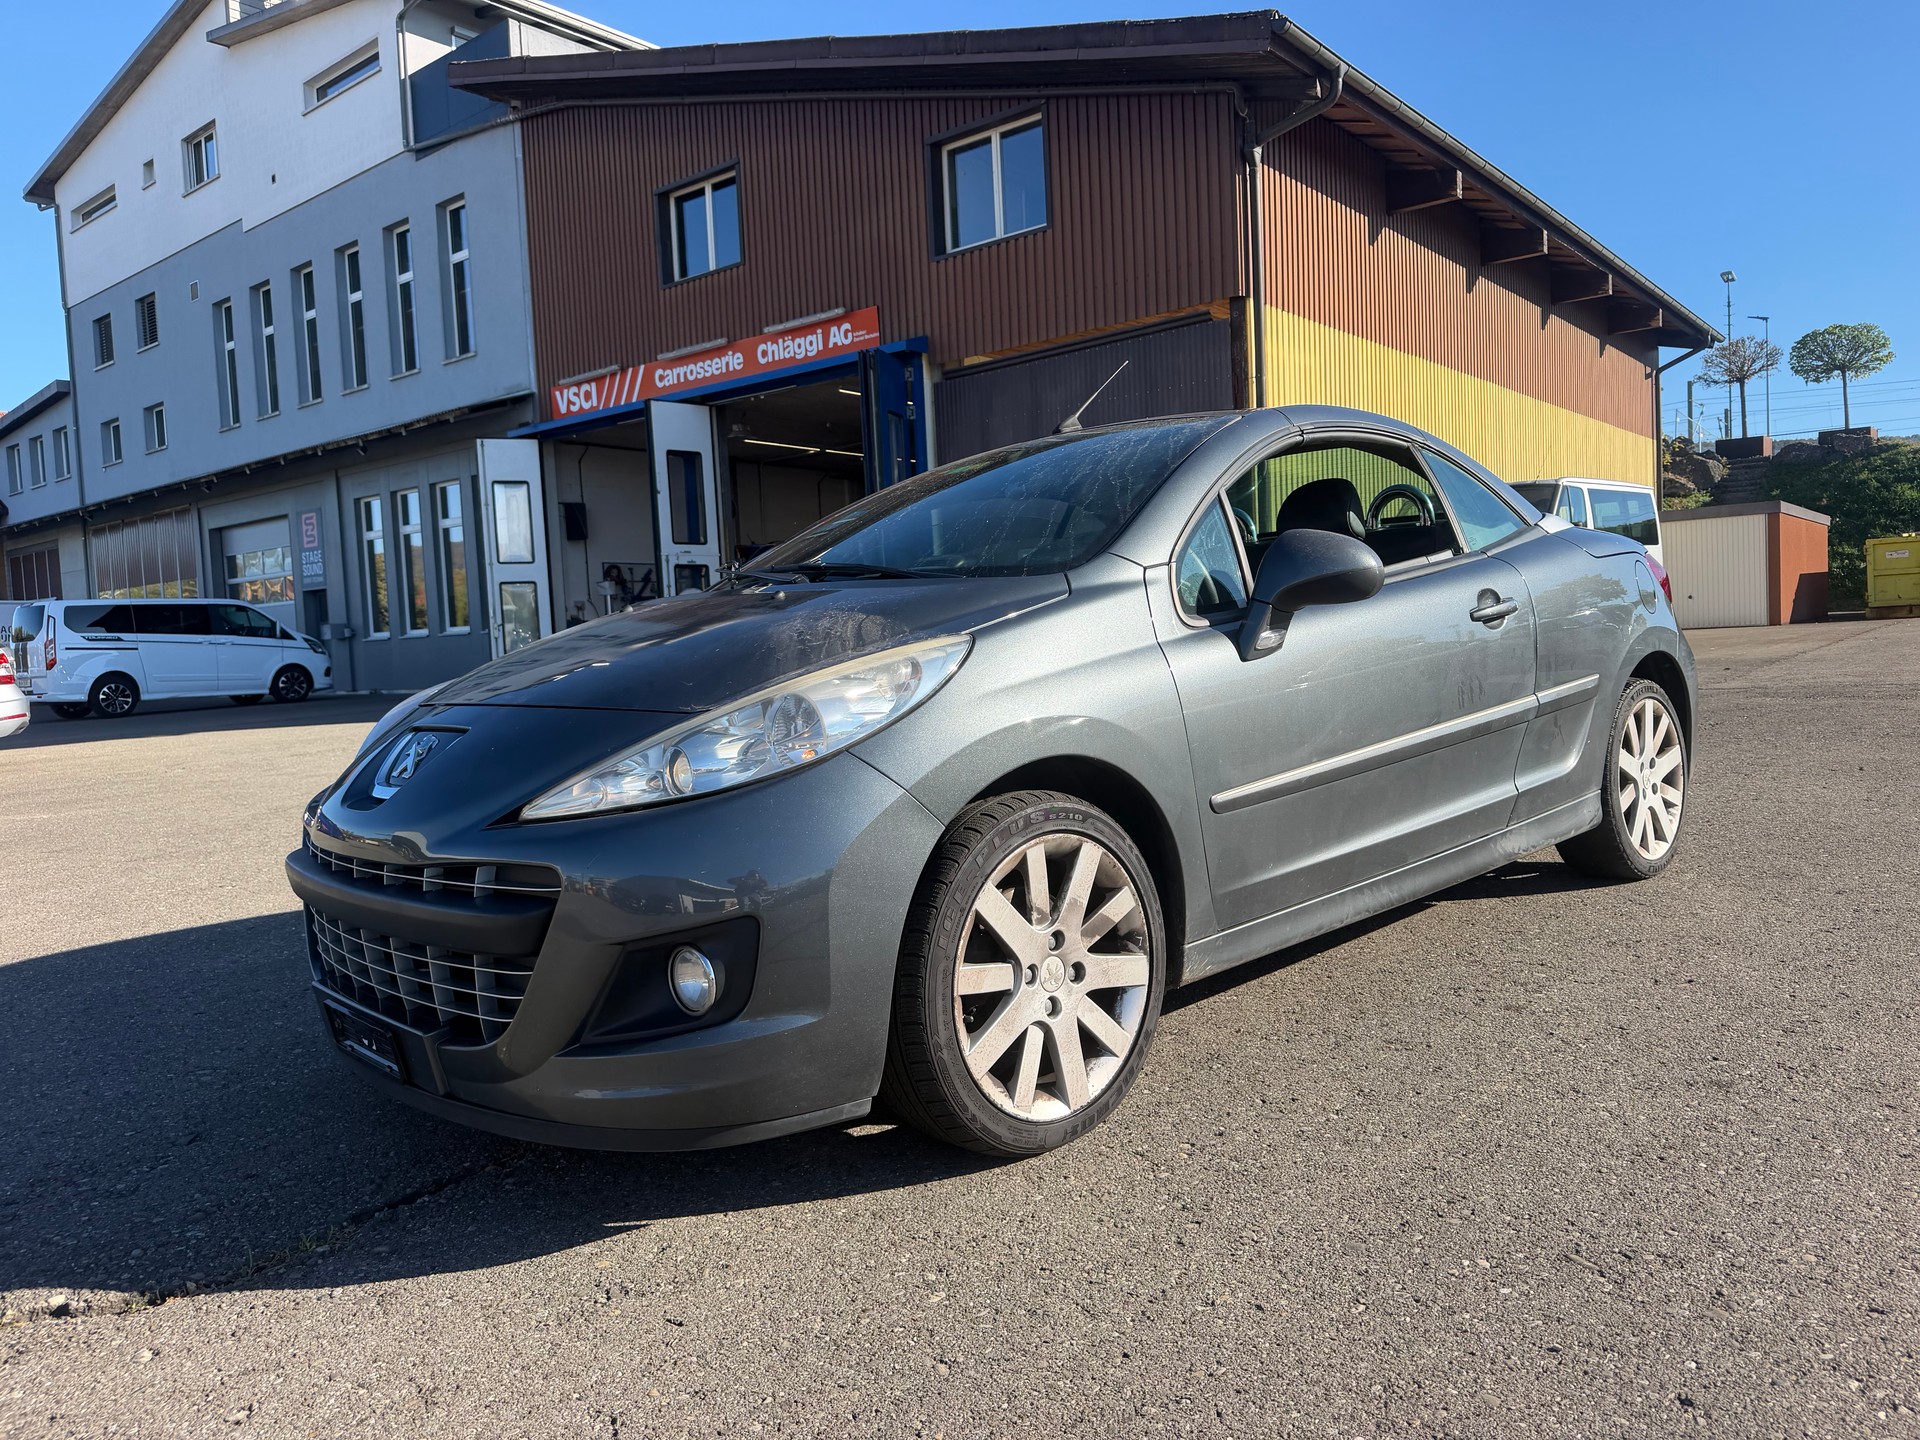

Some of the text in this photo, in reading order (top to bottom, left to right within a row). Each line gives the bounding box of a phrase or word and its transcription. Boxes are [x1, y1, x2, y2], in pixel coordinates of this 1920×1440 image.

[555, 322, 853, 414] VSCI Carrosserie Chläggi AG
[302, 551, 322, 564] STAGE
[303, 563, 324, 576] SOUND
